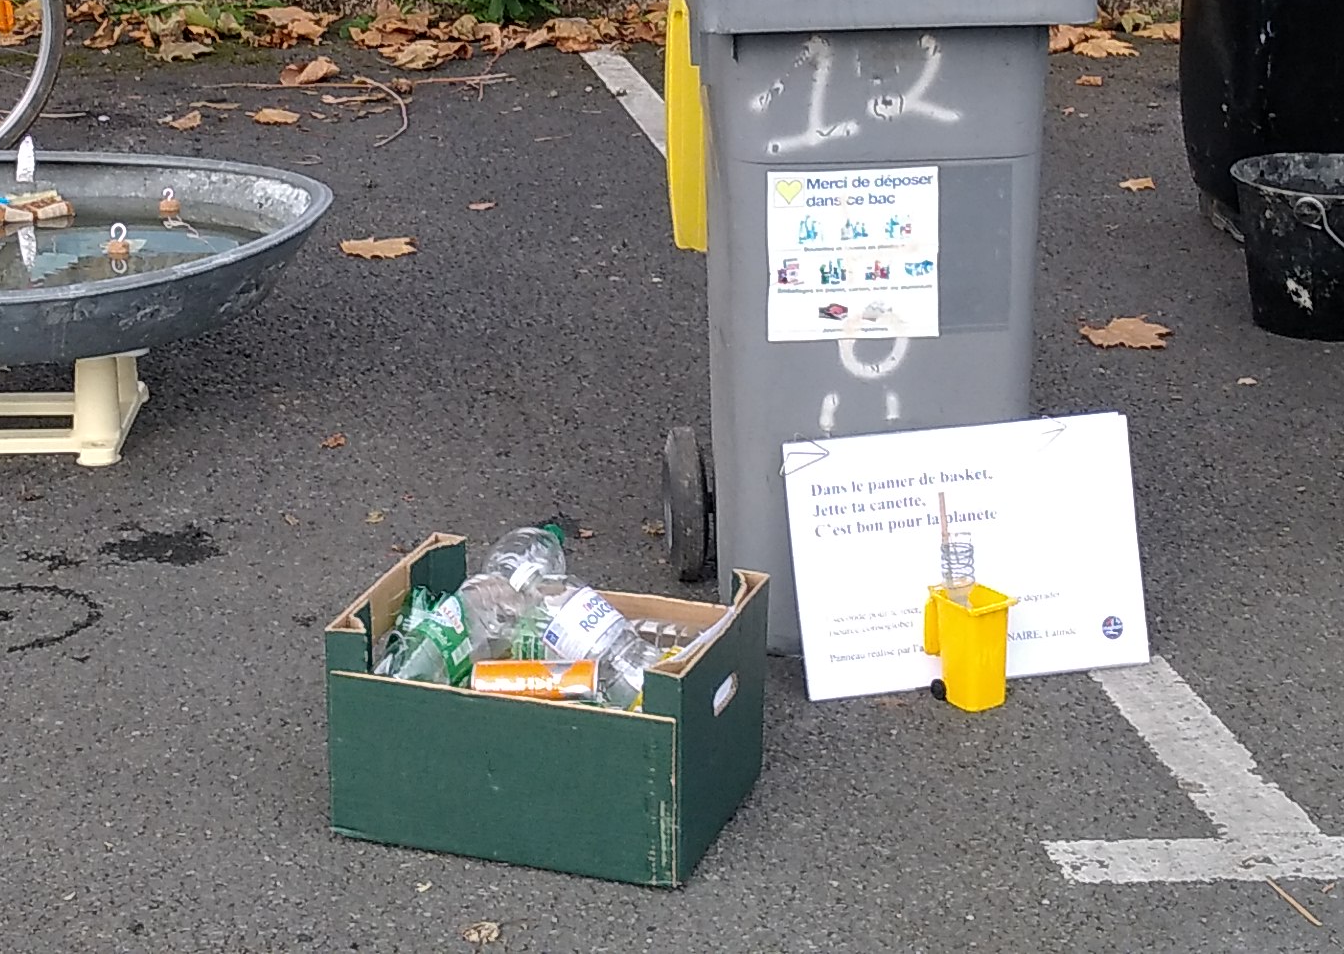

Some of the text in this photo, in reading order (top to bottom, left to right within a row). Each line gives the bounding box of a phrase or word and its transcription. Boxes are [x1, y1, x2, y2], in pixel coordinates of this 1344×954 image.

[806, 174, 934, 190] Merci de déposer
[806, 193, 896, 208] dans ce bac
[811, 484, 847, 497] Dans
[851, 481, 864, 493] le
[868, 477, 915, 494] panier
[919, 473, 936, 486] de
[813, 504, 848, 518] Jette
[852, 502, 866, 513] ta
[814, 523, 852, 538] C'est
[856, 521, 884, 534] bon
[888, 516, 923, 534] pour
[926, 513, 939, 526] la
